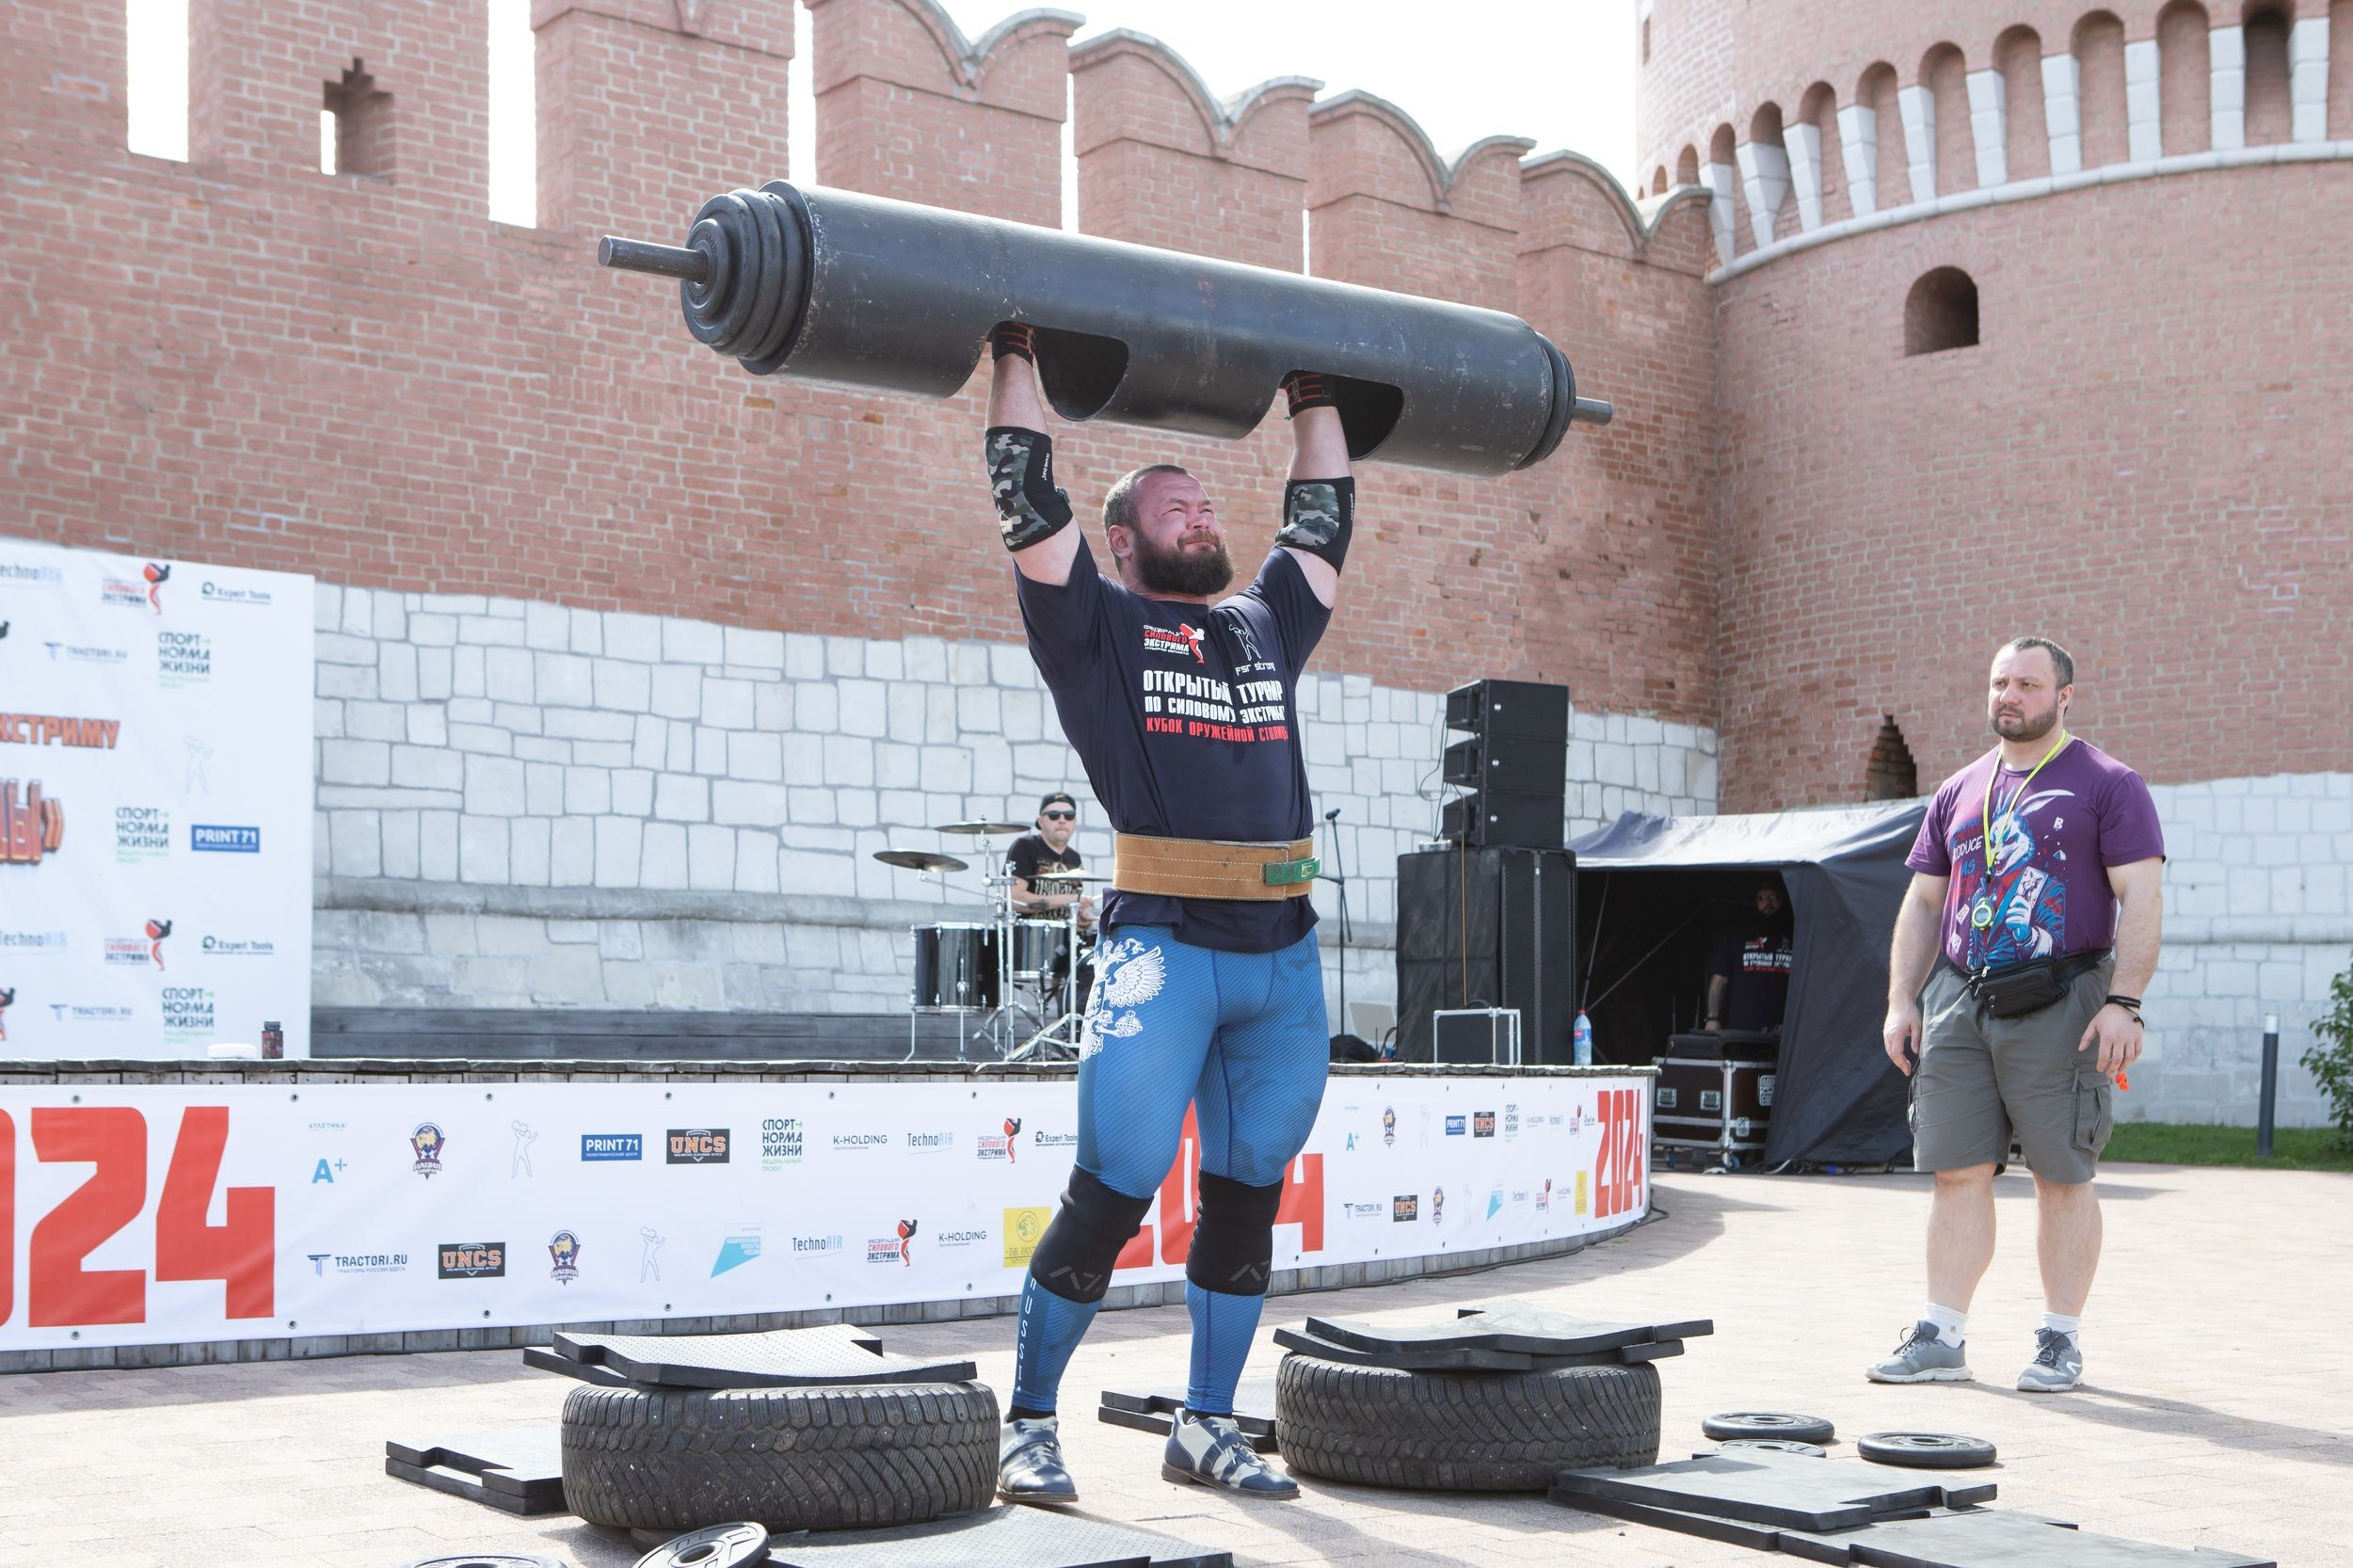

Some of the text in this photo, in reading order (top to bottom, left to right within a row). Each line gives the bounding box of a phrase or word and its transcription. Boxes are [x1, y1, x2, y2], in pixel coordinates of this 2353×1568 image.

[158, 632, 200, 646] СПОРТ
[1144, 630, 1188, 644] СИЛОВОГО
[1144, 638, 1190, 652] ЭКСТРИМА
[158, 646, 210, 660] НОРМА
[158, 660, 210, 675] ЖИЗНИ
[1143, 669, 1233, 706] ОТКРЫТЫЙ
[1144, 696, 1161, 712] ПО
[1145, 717, 1183, 734] КУБОК
[1189, 721, 1255, 743] ОРУЖЕЙНОЙ
[116, 806, 159, 821] СПОРТ
[116, 821, 168, 835] НОРМА
[117, 835, 169, 849] ЖИЗНИ
[218, 940, 274, 952] Expert Tools
[162, 988, 203, 1000] СПОРТ
[162, 1001, 215, 1015] НОРМА
[163, 1016, 215, 1029] ЖИЗНИ
[761, 1118, 795, 1130] СПОРТ
[669, 1136, 727, 1153] UNCS
[761, 1131, 803, 1144] НОРМА
[833, 1134, 888, 1145] K-HOLDING
[907, 1132, 953, 1147] TechnoAIR
[1045, 1134, 1063, 1143] Expert
[761, 1144, 802, 1157] ЖИЗНИ
[977, 1148, 1006, 1157] ЭКСТРИМА
[1594, 1089, 1643, 1219] 2024
[0, 1106, 275, 1328] 24
[792, 1235, 842, 1251] TechnoAIR
[938, 1230, 987, 1242] K-HOLDING
[867, 1242, 900, 1252] СИЛОВОГО
[334, 1254, 408, 1267] TRACTORI.RU
[442, 1249, 502, 1268] UNCS
[867, 1251, 900, 1261] ЭКСТРИМА
